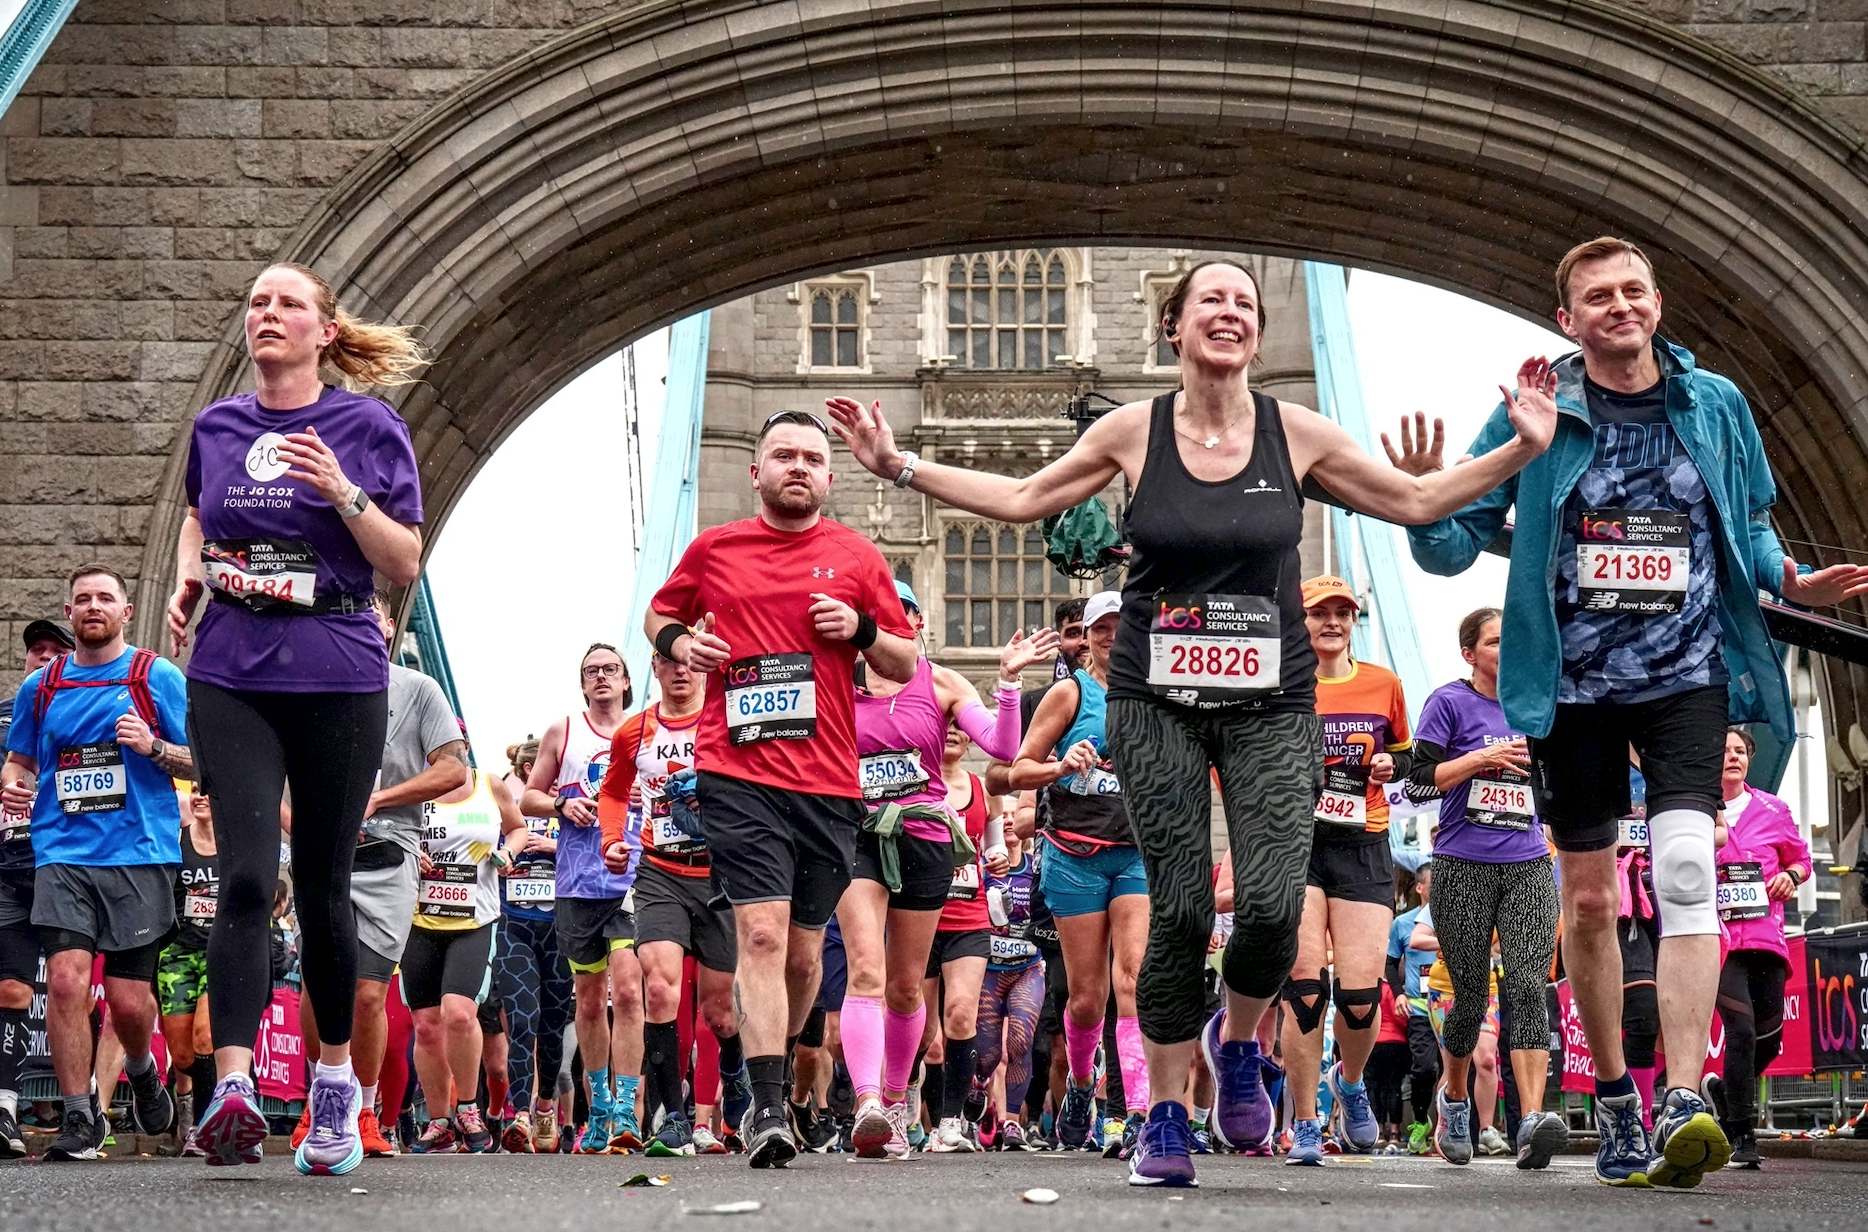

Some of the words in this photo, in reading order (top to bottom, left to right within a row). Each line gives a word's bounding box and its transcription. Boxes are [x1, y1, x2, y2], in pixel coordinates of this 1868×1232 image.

[1591, 422, 1675, 470] LDN
[227, 486, 246, 496] THE
[248, 486, 265, 495] JO
[268, 487, 295, 497] COX
[223, 498, 292, 508] FOUNDATION
[1583, 516, 1623, 540] tcs
[1627, 525, 1683, 534] CONSULTANCY
[1627, 533, 1663, 541] SERVICES
[250, 544, 274, 552] TATA
[250, 553, 307, 562] CONSULTANCY
[250, 562, 286, 571] SERVICES
[1594, 553, 1671, 581] 21369
[219, 572, 293, 601] 29184
[1207, 602, 1235, 611] TATA
[1640, 601, 1674, 610] balance
[1159, 602, 1202, 629] tcs
[1207, 611, 1271, 622] CONSULTANCY
[1207, 621, 1248, 631] SERVICES
[760, 659, 780, 667] TATA
[1170, 645, 1260, 677] 28826
[760, 664, 807, 674] CONSULTANCY
[728, 665, 758, 685] tcs
[761, 672, 791, 680] SERVICES
[739, 689, 801, 716] 62857
[1199, 701, 1221, 709] new
[761, 731, 775, 739] new
[776, 728, 809, 736] balance
[1483, 735, 1510, 745] East
[82, 751, 119, 759] CONSULTANCY
[1345, 756, 1361, 765] UK
[865, 759, 917, 782] 55034
[64, 772, 114, 793] 58769
[1097, 778, 1119, 795] 62
[1329, 777, 1364, 786] CONSULTANCY
[1329, 782, 1352, 790] SERVICES
[1480, 787, 1525, 808] 24316
[457, 813, 490, 825] ANNA
[1507, 820, 1528, 828] balance
[663, 823, 684, 838] 59
[428, 886, 468, 901] 23666
[515, 883, 551, 896] 57570
[1718, 887, 1757, 904] 59380
[993, 940, 1029, 956] 59494
[1783, 995, 1800, 1020] NCY
[1814, 958, 1857, 1052] tcs
[3, 1023, 15, 1055] 2XU
[271, 1032, 301, 1055] CONSULTANCY
